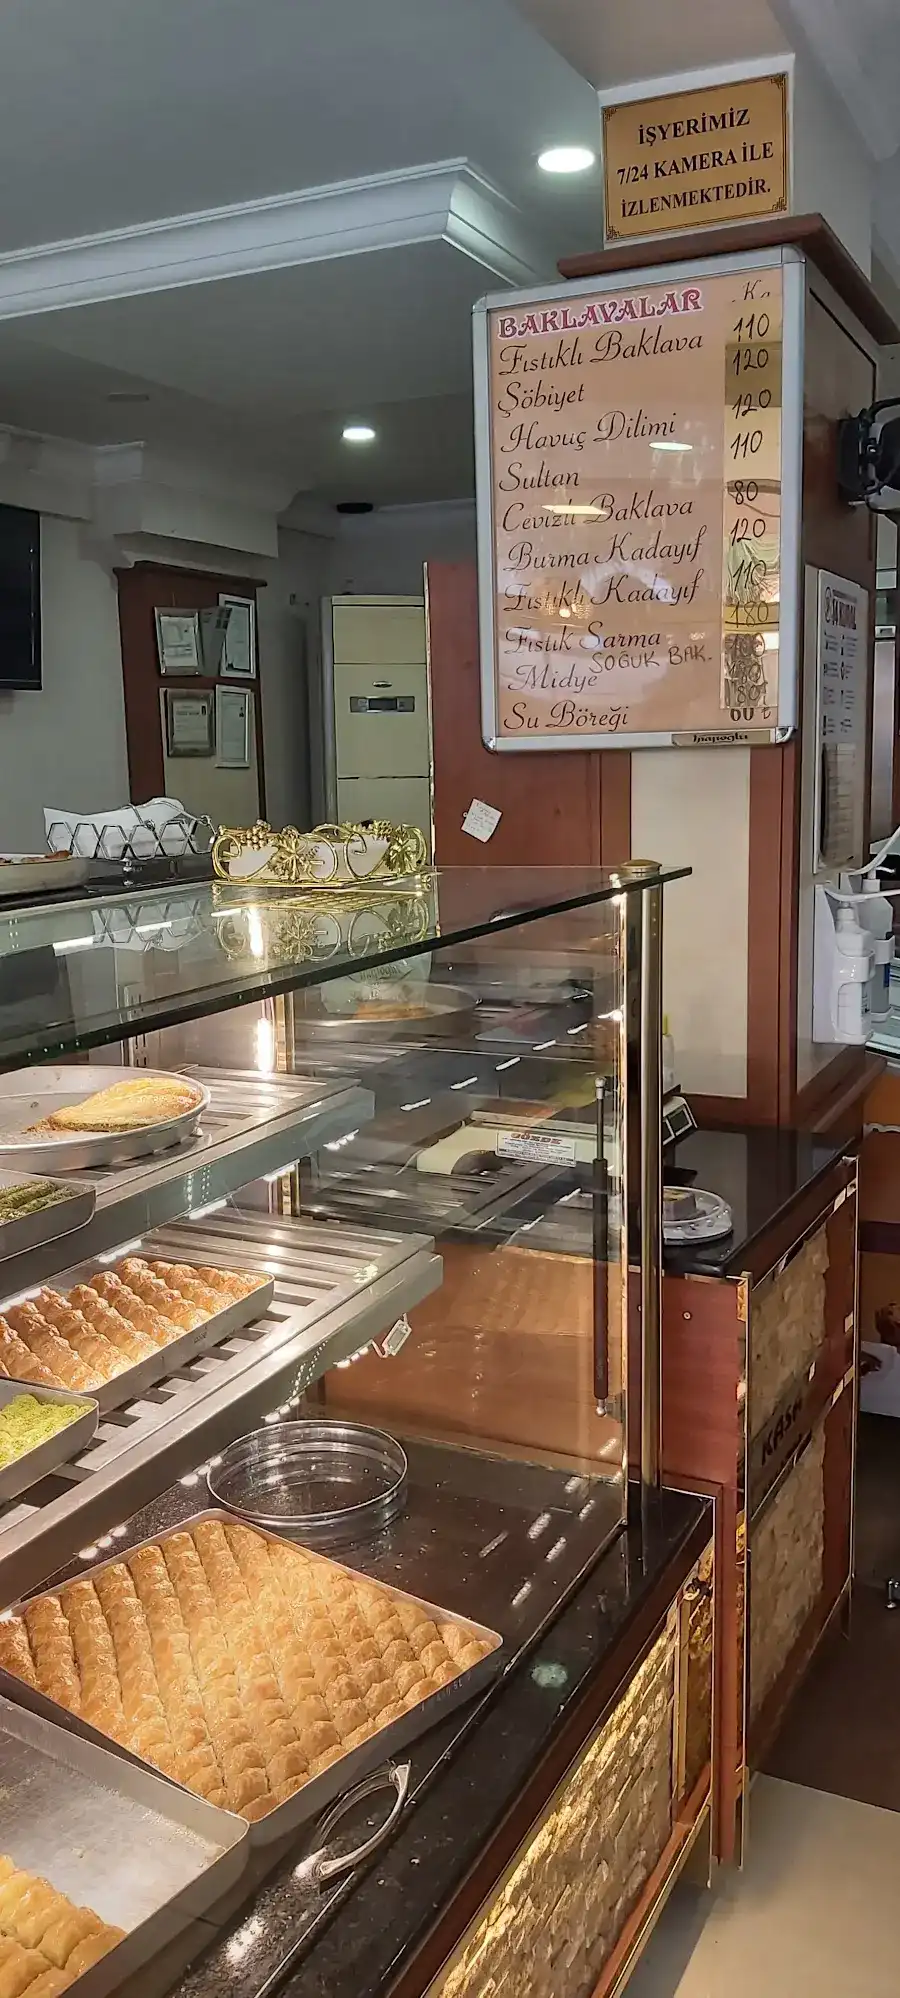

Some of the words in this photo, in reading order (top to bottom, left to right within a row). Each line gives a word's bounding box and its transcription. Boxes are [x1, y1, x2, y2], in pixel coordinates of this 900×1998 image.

[638, 107, 750, 146] İŞYERİMİZ
[617, 164, 648, 185] 7/24
[654, 149, 737, 178] KAMERA
[742, 141, 774, 162] İLE
[620, 177, 771, 217] İZLENMEKTEDİR.
[498, 288, 702, 339] BAKLAVALAR
[733, 313, 770, 342] 110
[498, 337, 583, 376] Fıstıklı
[589, 325, 703, 363] Baklava
[733, 349, 769, 376] 120
[498, 379, 585, 418] Şöbiyet
[732, 389, 771, 419] 120
[500, 421, 587, 453] Havuç
[593, 409, 676, 442] Dilimi
[730, 430, 763, 460] 110
[498, 461, 580, 492] Sultan
[734, 480, 759, 505] 80
[583, 490, 694, 524] Baklava
[503, 541, 589, 572] Burma
[594, 525, 708, 564] Kadayıf
[730, 518, 766, 547] 120
[590, 568, 705, 607] Kadayıf
[733, 559, 767, 591] 110
[730, 601, 769, 628] 180
[504, 625, 574, 654] Fıstık
[579, 621, 661, 650] Sarma
[588, 651, 660, 674] SOĞUK
[668, 645, 713, 666] BAK.
[507, 664, 598, 693] Midye
[503, 702, 540, 730] Su
[545, 699, 630, 732] Böreği
